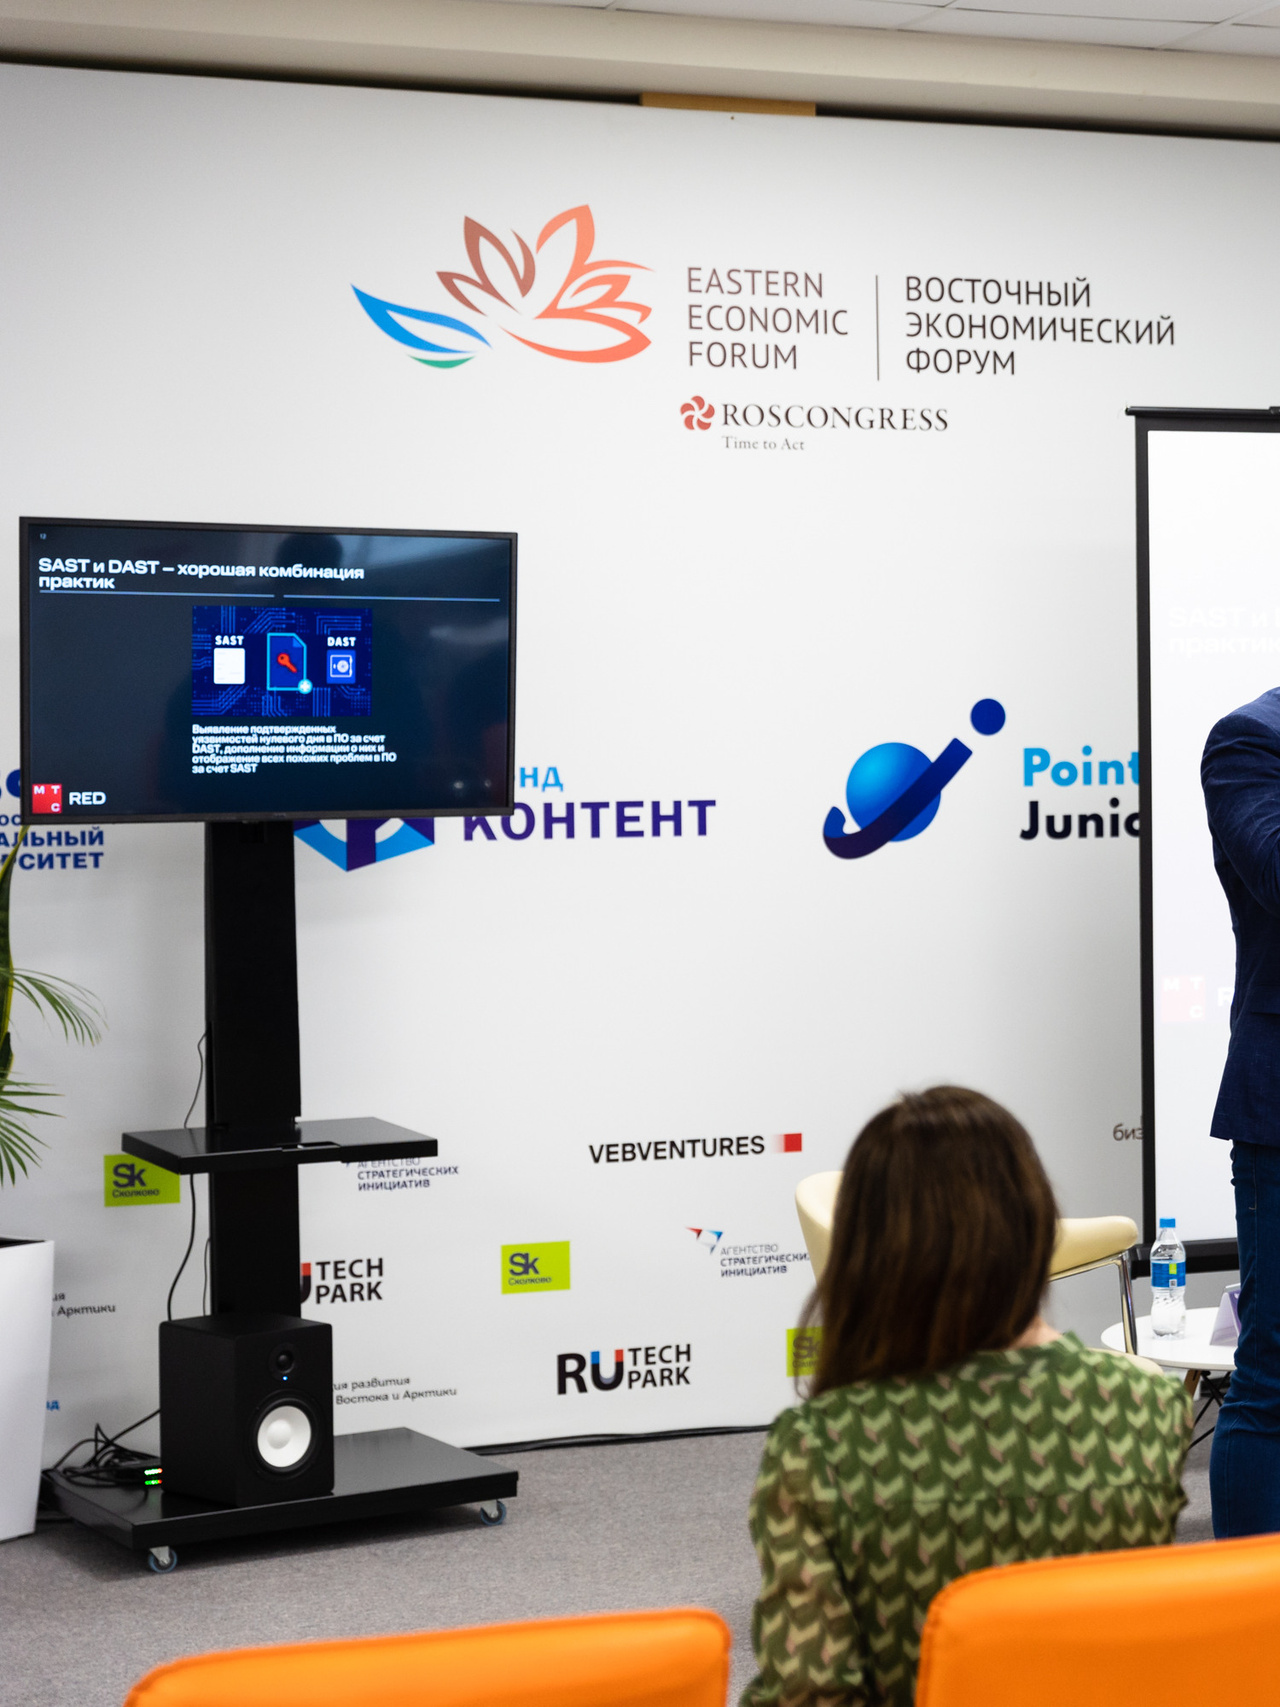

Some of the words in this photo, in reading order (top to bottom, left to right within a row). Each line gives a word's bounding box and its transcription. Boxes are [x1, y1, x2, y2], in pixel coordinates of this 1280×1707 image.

[687, 267, 823, 298] EASTERN
[905, 276, 1091, 307] ВОСТОЧНЫЙ
[688, 304, 849, 336] ECONOMIC
[905, 312, 1175, 346] ЭКОНОМИЧЕСКИЙ
[689, 341, 798, 370] FORUM
[906, 348, 1015, 375] ФОРУМ
[721, 403, 949, 432] ROSCONGRESS
[722, 435, 758, 450] Time
[763, 437, 777, 451] to
[780, 437, 805, 452] Act
[38, 558, 90, 573] SAST
[92, 561, 105, 573] и
[108, 559, 160, 575] DAST
[177, 563, 256, 579] хорошая
[258, 563, 364, 581] комбинация
[38, 576, 115, 591] практик
[1168, 606, 1246, 628] SAST
[1250, 610, 1269, 628] и
[215, 635, 244, 646] SAST
[327, 637, 356, 647] DAST
[192, 723, 249, 735] Выявление
[250, 725, 337, 736] подтвержденных
[192, 733, 258, 744] уязвимостей
[259, 735, 305, 745] нулевого
[305, 735, 325, 745] дня
[333, 733, 349, 743] ПО
[350, 735, 362, 743] за
[363, 735, 386, 743] счет
[192, 744, 224, 755] DAST,
[224, 745, 285, 755] дополнение
[286, 744, 350, 755] информации
[358, 744, 377, 753] них
[192, 753, 260, 764] отображение
[261, 754, 285, 763] всех
[286, 754, 329, 763] похожих
[330, 753, 373, 764] проблем
[381, 752, 397, 762] ПО
[192, 765, 204, 774] за
[206, 765, 229, 774] счет
[230, 763, 258, 773] SAST
[1023, 744, 1139, 787] Point
[514, 766, 564, 792] НД
[69, 791, 107, 805] RED
[464, 800, 716, 841] КОНТЕНТ
[589, 1135, 765, 1164] VEBVENTURES
[112, 1162, 147, 1189] Sk
[357, 1165, 459, 1180] СТРАТЕГИЧЕСКИХ
[358, 1179, 430, 1191] ИНИЦИАТИВ
[720, 1243, 778, 1256] АГЕНТСТВО
[315, 1257, 384, 1281] TECH
[508, 1252, 540, 1276] Sk
[720, 1265, 787, 1278] ИНИЦИАТИВ
[315, 1281, 384, 1305] PARK
[557, 1349, 624, 1395] RU
[628, 1344, 692, 1366] TECH
[628, 1366, 691, 1389] PARK
